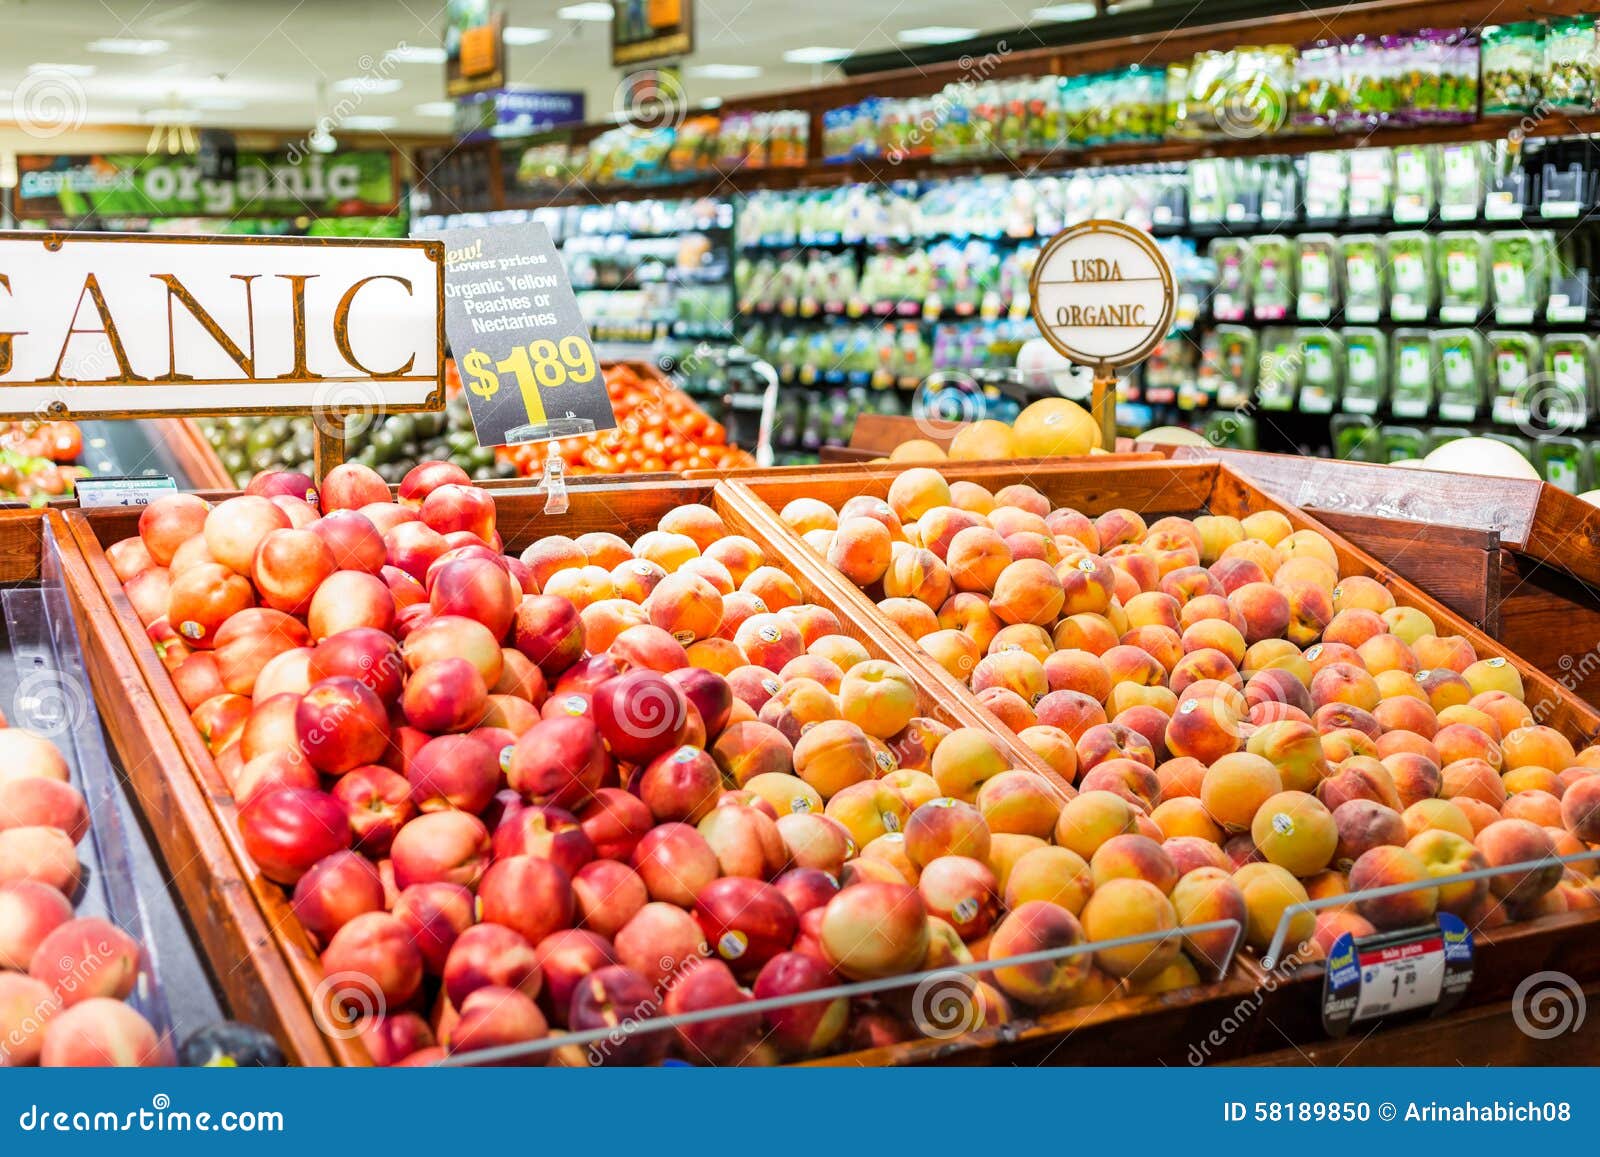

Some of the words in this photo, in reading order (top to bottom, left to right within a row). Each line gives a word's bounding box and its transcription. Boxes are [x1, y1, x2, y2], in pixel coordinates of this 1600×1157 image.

[144, 156, 359, 213] organic
[445, 239, 482, 265] ew!
[449, 258, 496, 273] Lower
[499, 253, 547, 271] prices
[1072, 259, 1123, 283] USDA
[445, 278, 504, 299] Organic
[507, 273, 558, 291] Yellow
[464, 296, 531, 315] Peaches
[535, 294, 550, 307] or
[1056, 304, 1146, 327] ORGANIC
[471, 312, 558, 334] Nectarines
